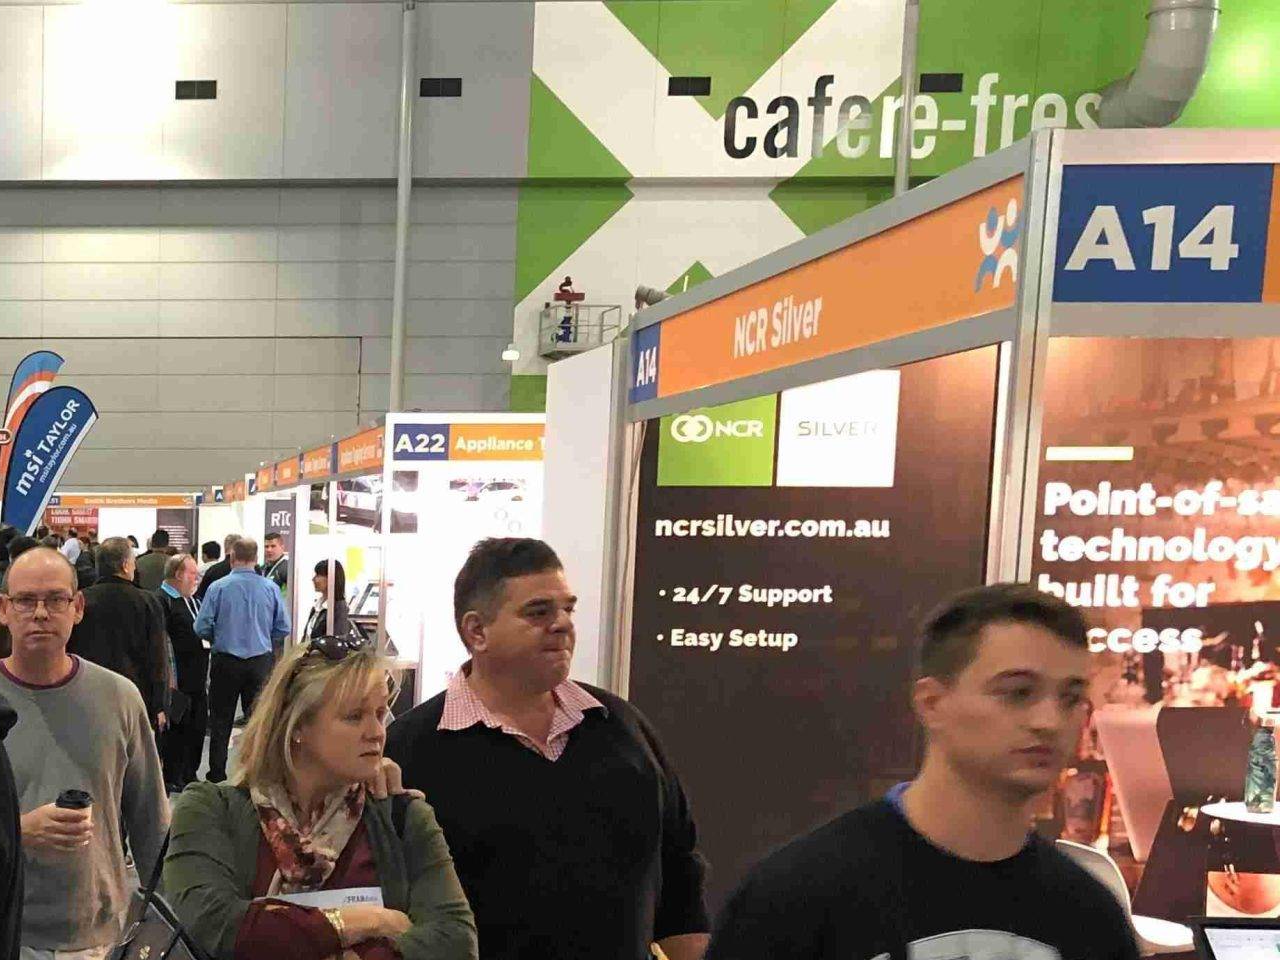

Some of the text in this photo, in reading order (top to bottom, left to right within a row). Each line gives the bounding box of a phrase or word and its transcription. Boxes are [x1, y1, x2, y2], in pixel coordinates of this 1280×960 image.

[1063, 204, 1240, 272] A14
[733, 295, 823, 359] NCR Silver
[636, 346, 658, 387] A14
[715, 420, 764, 438] NCR
[797, 420, 878, 437] SILVER
[16, 399, 81, 496] msi TAYLOR
[394, 433, 446, 453] A22
[455, 436, 534, 453] Appliance
[655, 514, 890, 538] ncrsilver.com.au
[1040, 527, 1280, 571] technology
[672, 584, 834, 607] 24/7 Support
[1150, 573, 1216, 608] for
[670, 628, 799, 652] Easy Setup
[1086, 627, 1204, 653] ccess
